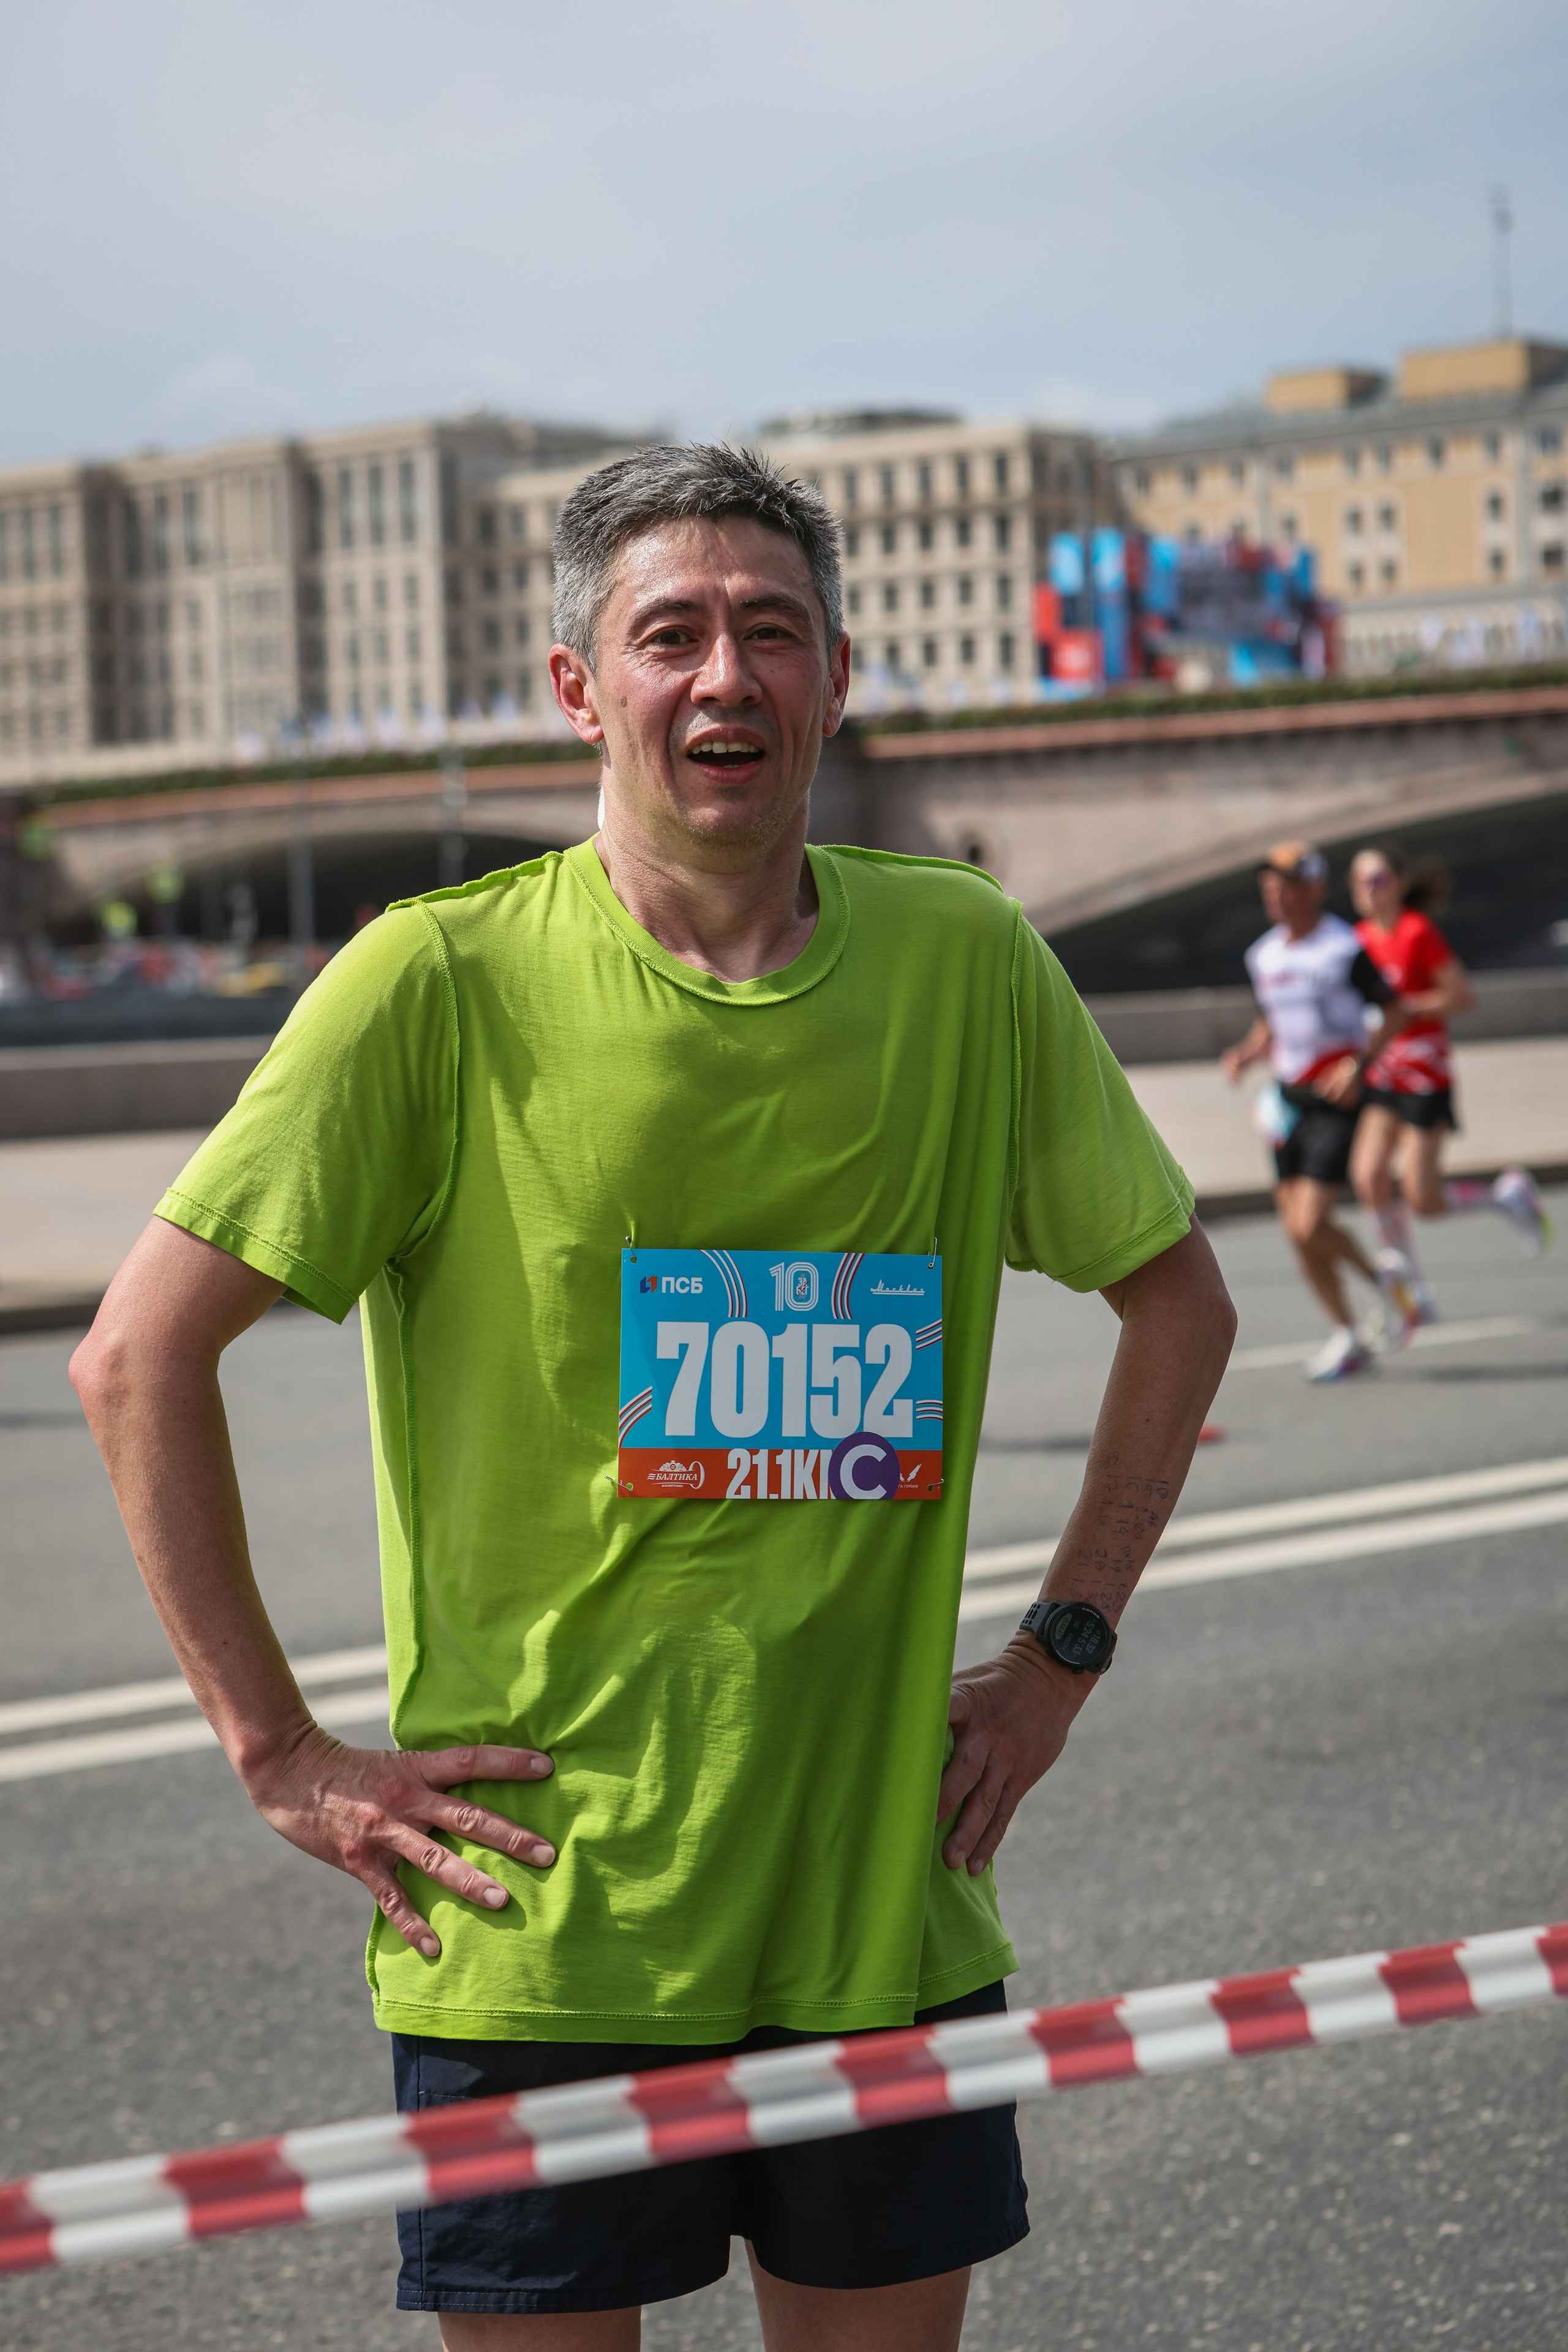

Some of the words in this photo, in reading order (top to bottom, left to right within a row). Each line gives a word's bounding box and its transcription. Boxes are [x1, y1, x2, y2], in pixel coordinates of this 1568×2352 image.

[662, 1276, 703, 1294] ПСБ
[769, 1262, 819, 1311] 10
[657, 1321, 913, 1439] 70152
[1082, 1607, 1099, 1619] COROS
